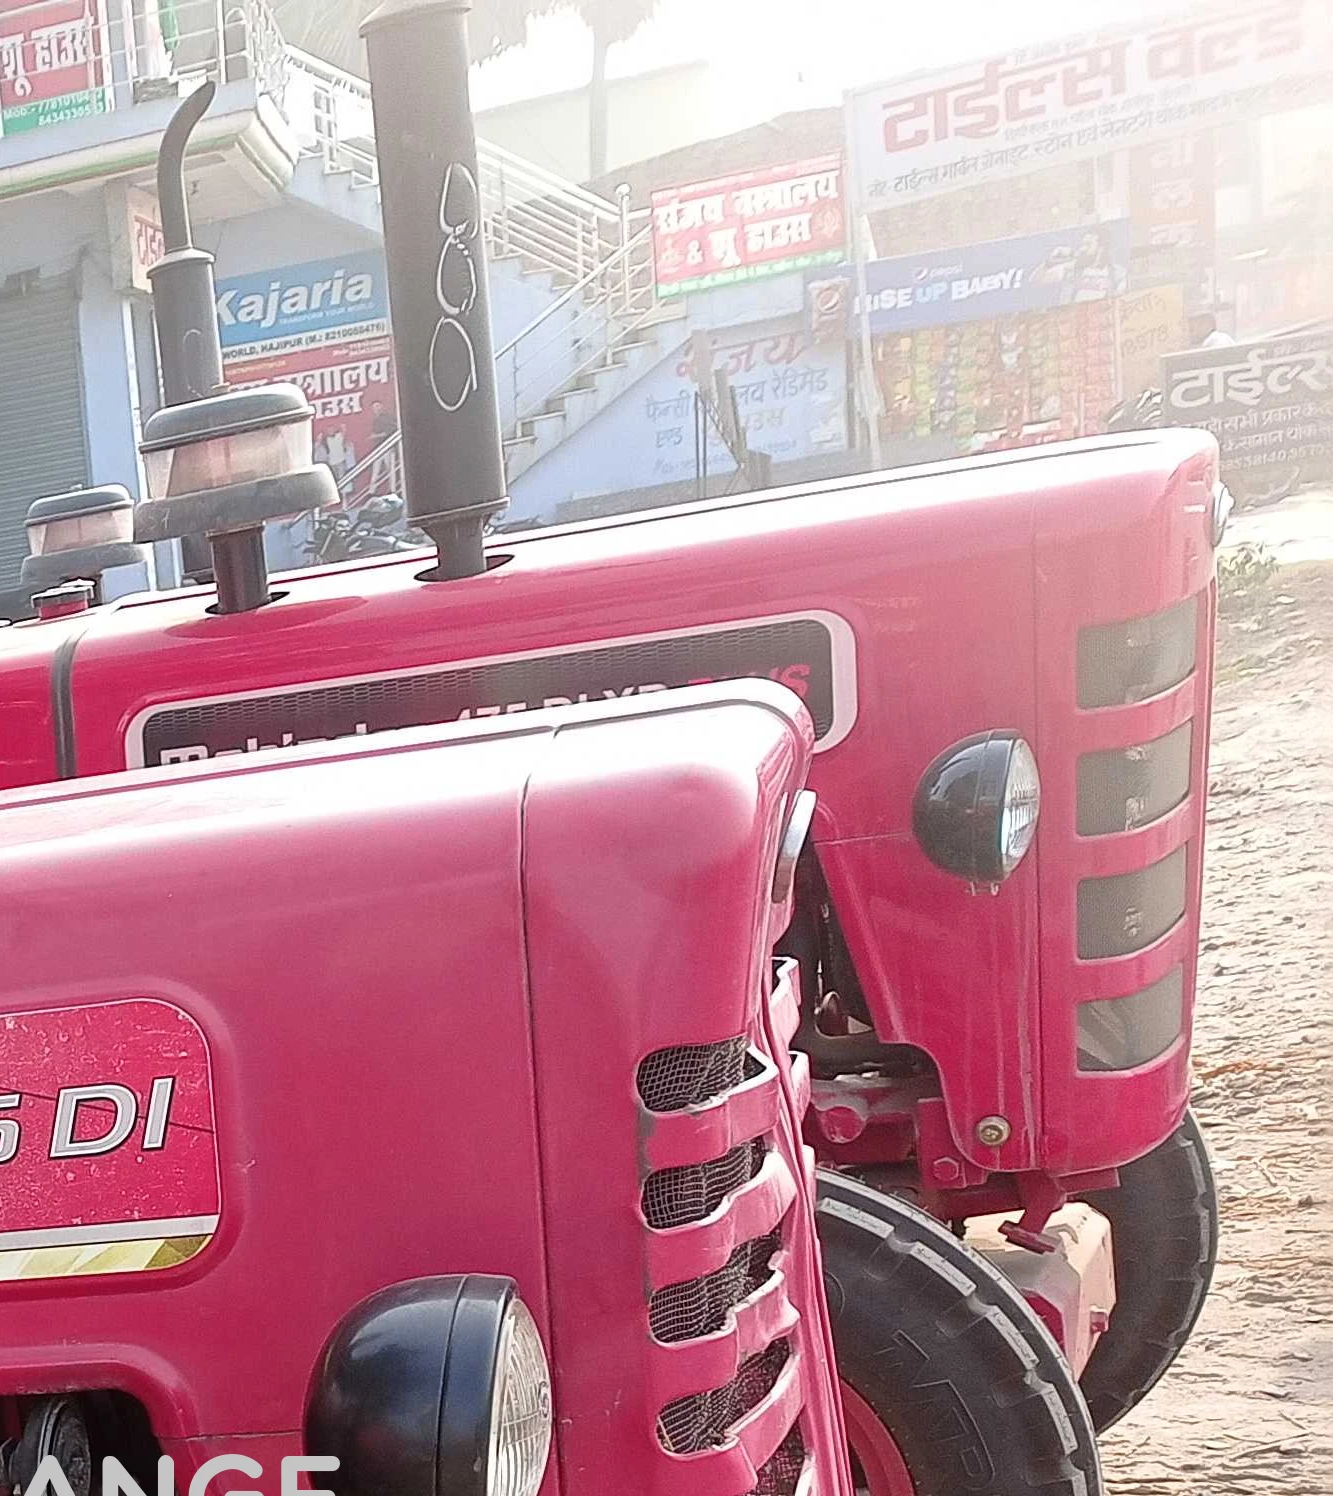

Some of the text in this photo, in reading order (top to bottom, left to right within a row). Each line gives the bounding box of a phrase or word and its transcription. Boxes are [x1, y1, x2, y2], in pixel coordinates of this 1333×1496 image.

[217, 268, 374, 329] Kajaria
[916, 281, 949, 303] UP
[951, 268, 1024, 301] BABY!
[48, 1076, 176, 1161] DI
